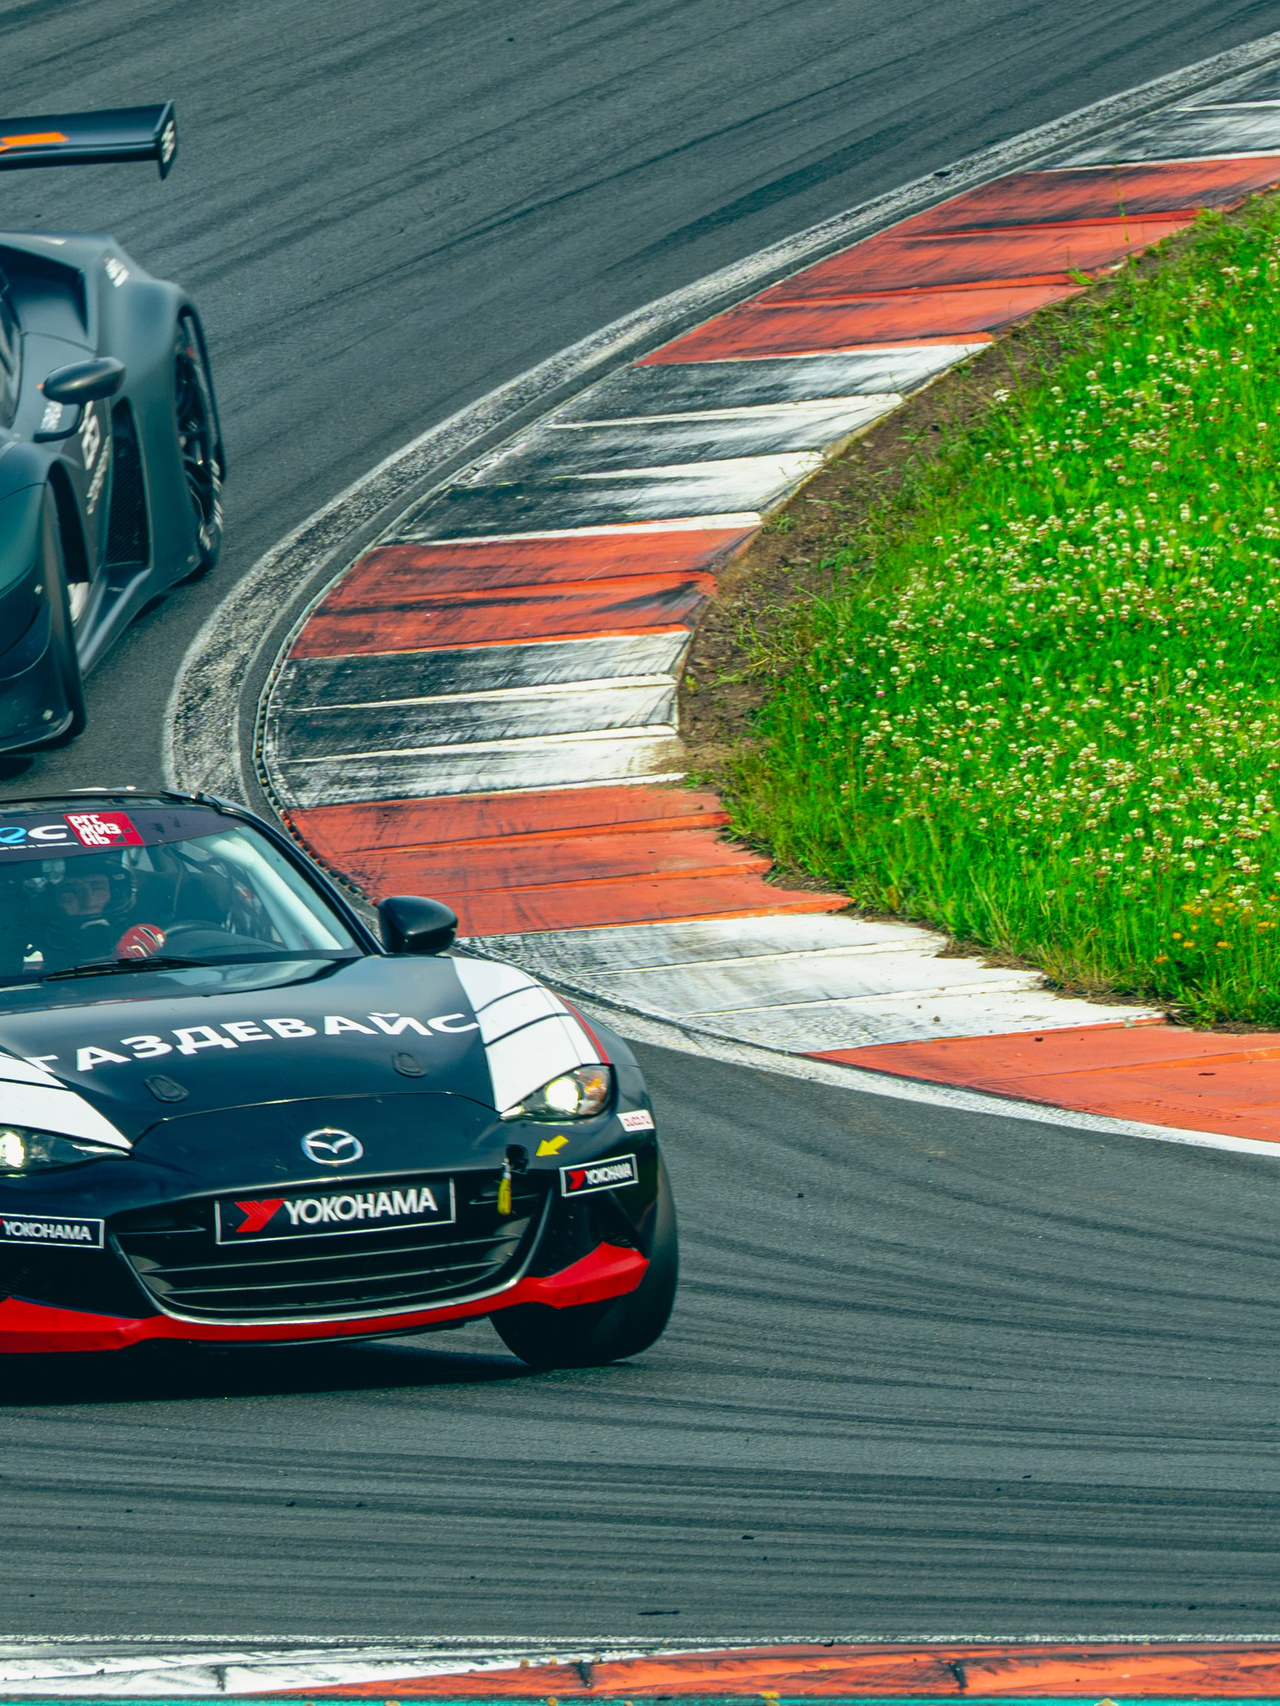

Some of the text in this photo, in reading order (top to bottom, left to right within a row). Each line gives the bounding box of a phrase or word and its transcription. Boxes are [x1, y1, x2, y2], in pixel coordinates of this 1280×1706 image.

[22, 1012, 480, 1074] ГАЗДЕВАЙС
[284, 1187, 439, 1226] YOKOHAMA
[2, 1220, 93, 1241] YOKOHAMA
